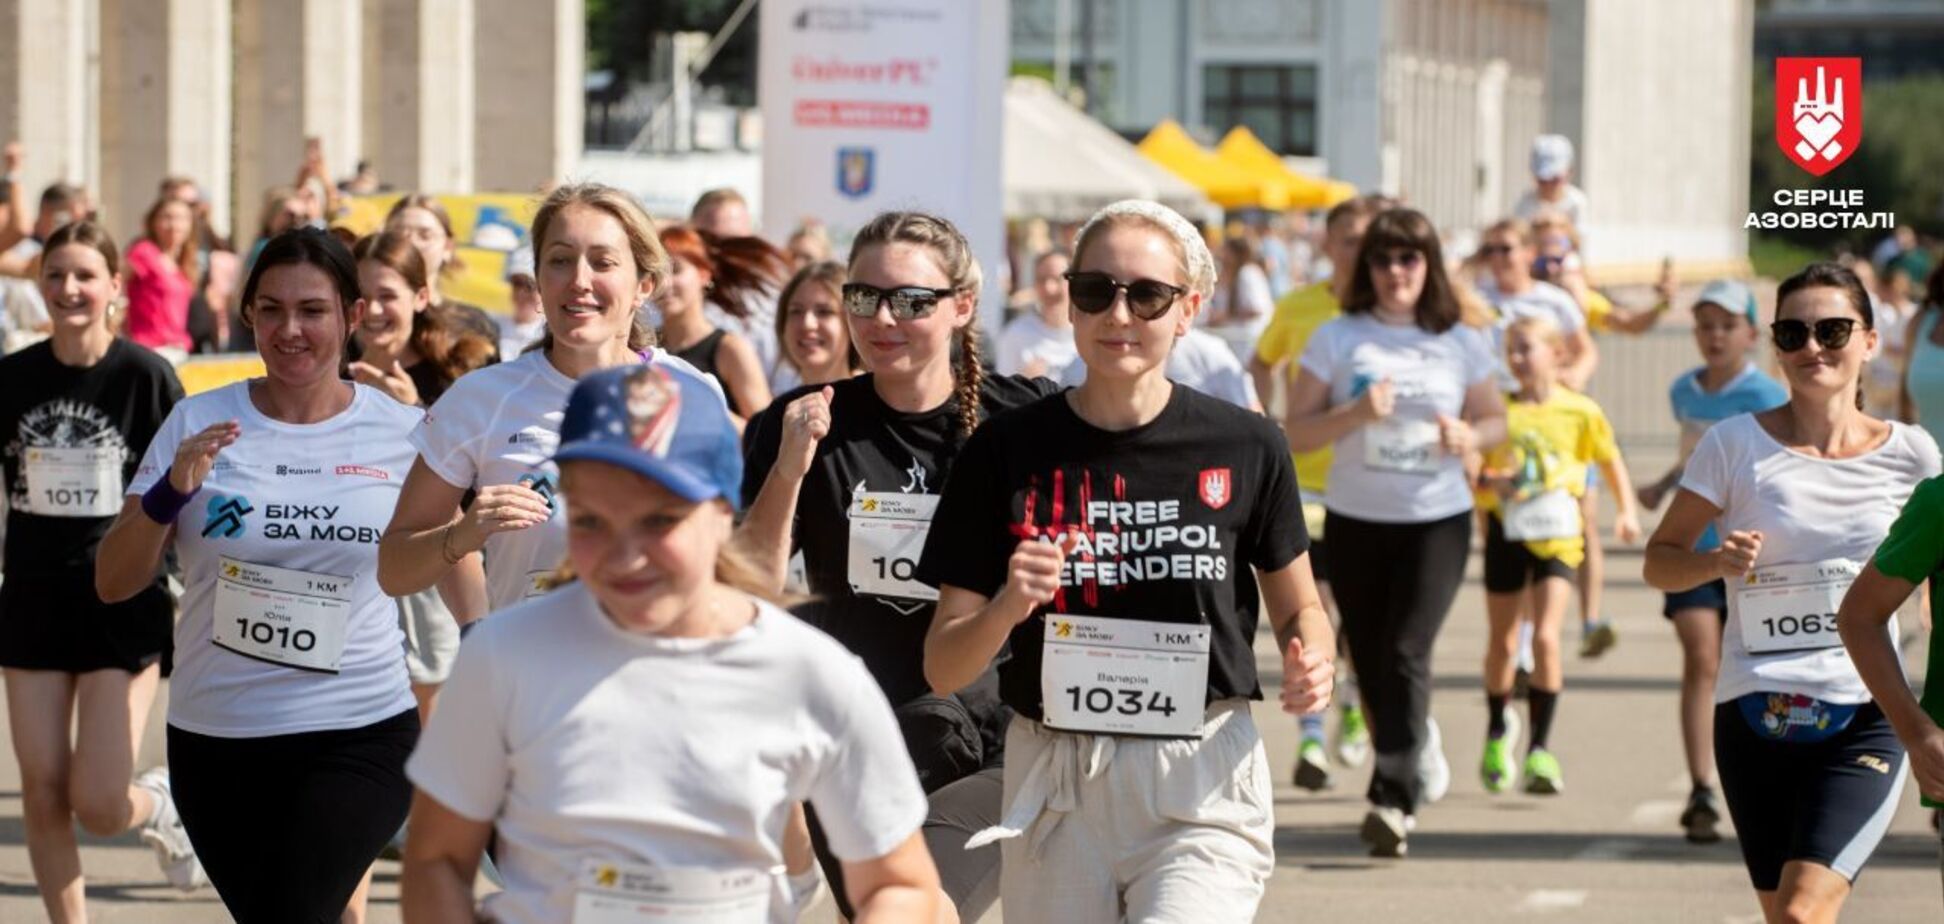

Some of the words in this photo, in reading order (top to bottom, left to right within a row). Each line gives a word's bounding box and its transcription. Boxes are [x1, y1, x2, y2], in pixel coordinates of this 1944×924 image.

[45, 489, 99, 505] 1017
[265, 505, 339, 519] БІЖУ
[1087, 500, 1180, 525] FREE
[264, 524, 300, 539] ЗА
[1060, 554, 1227, 586] EFENDERS
[236, 618, 317, 652] 1010
[1762, 613, 1839, 637] 1063
[1066, 686, 1177, 717] 1034
[1857, 755, 1890, 774] FILA
